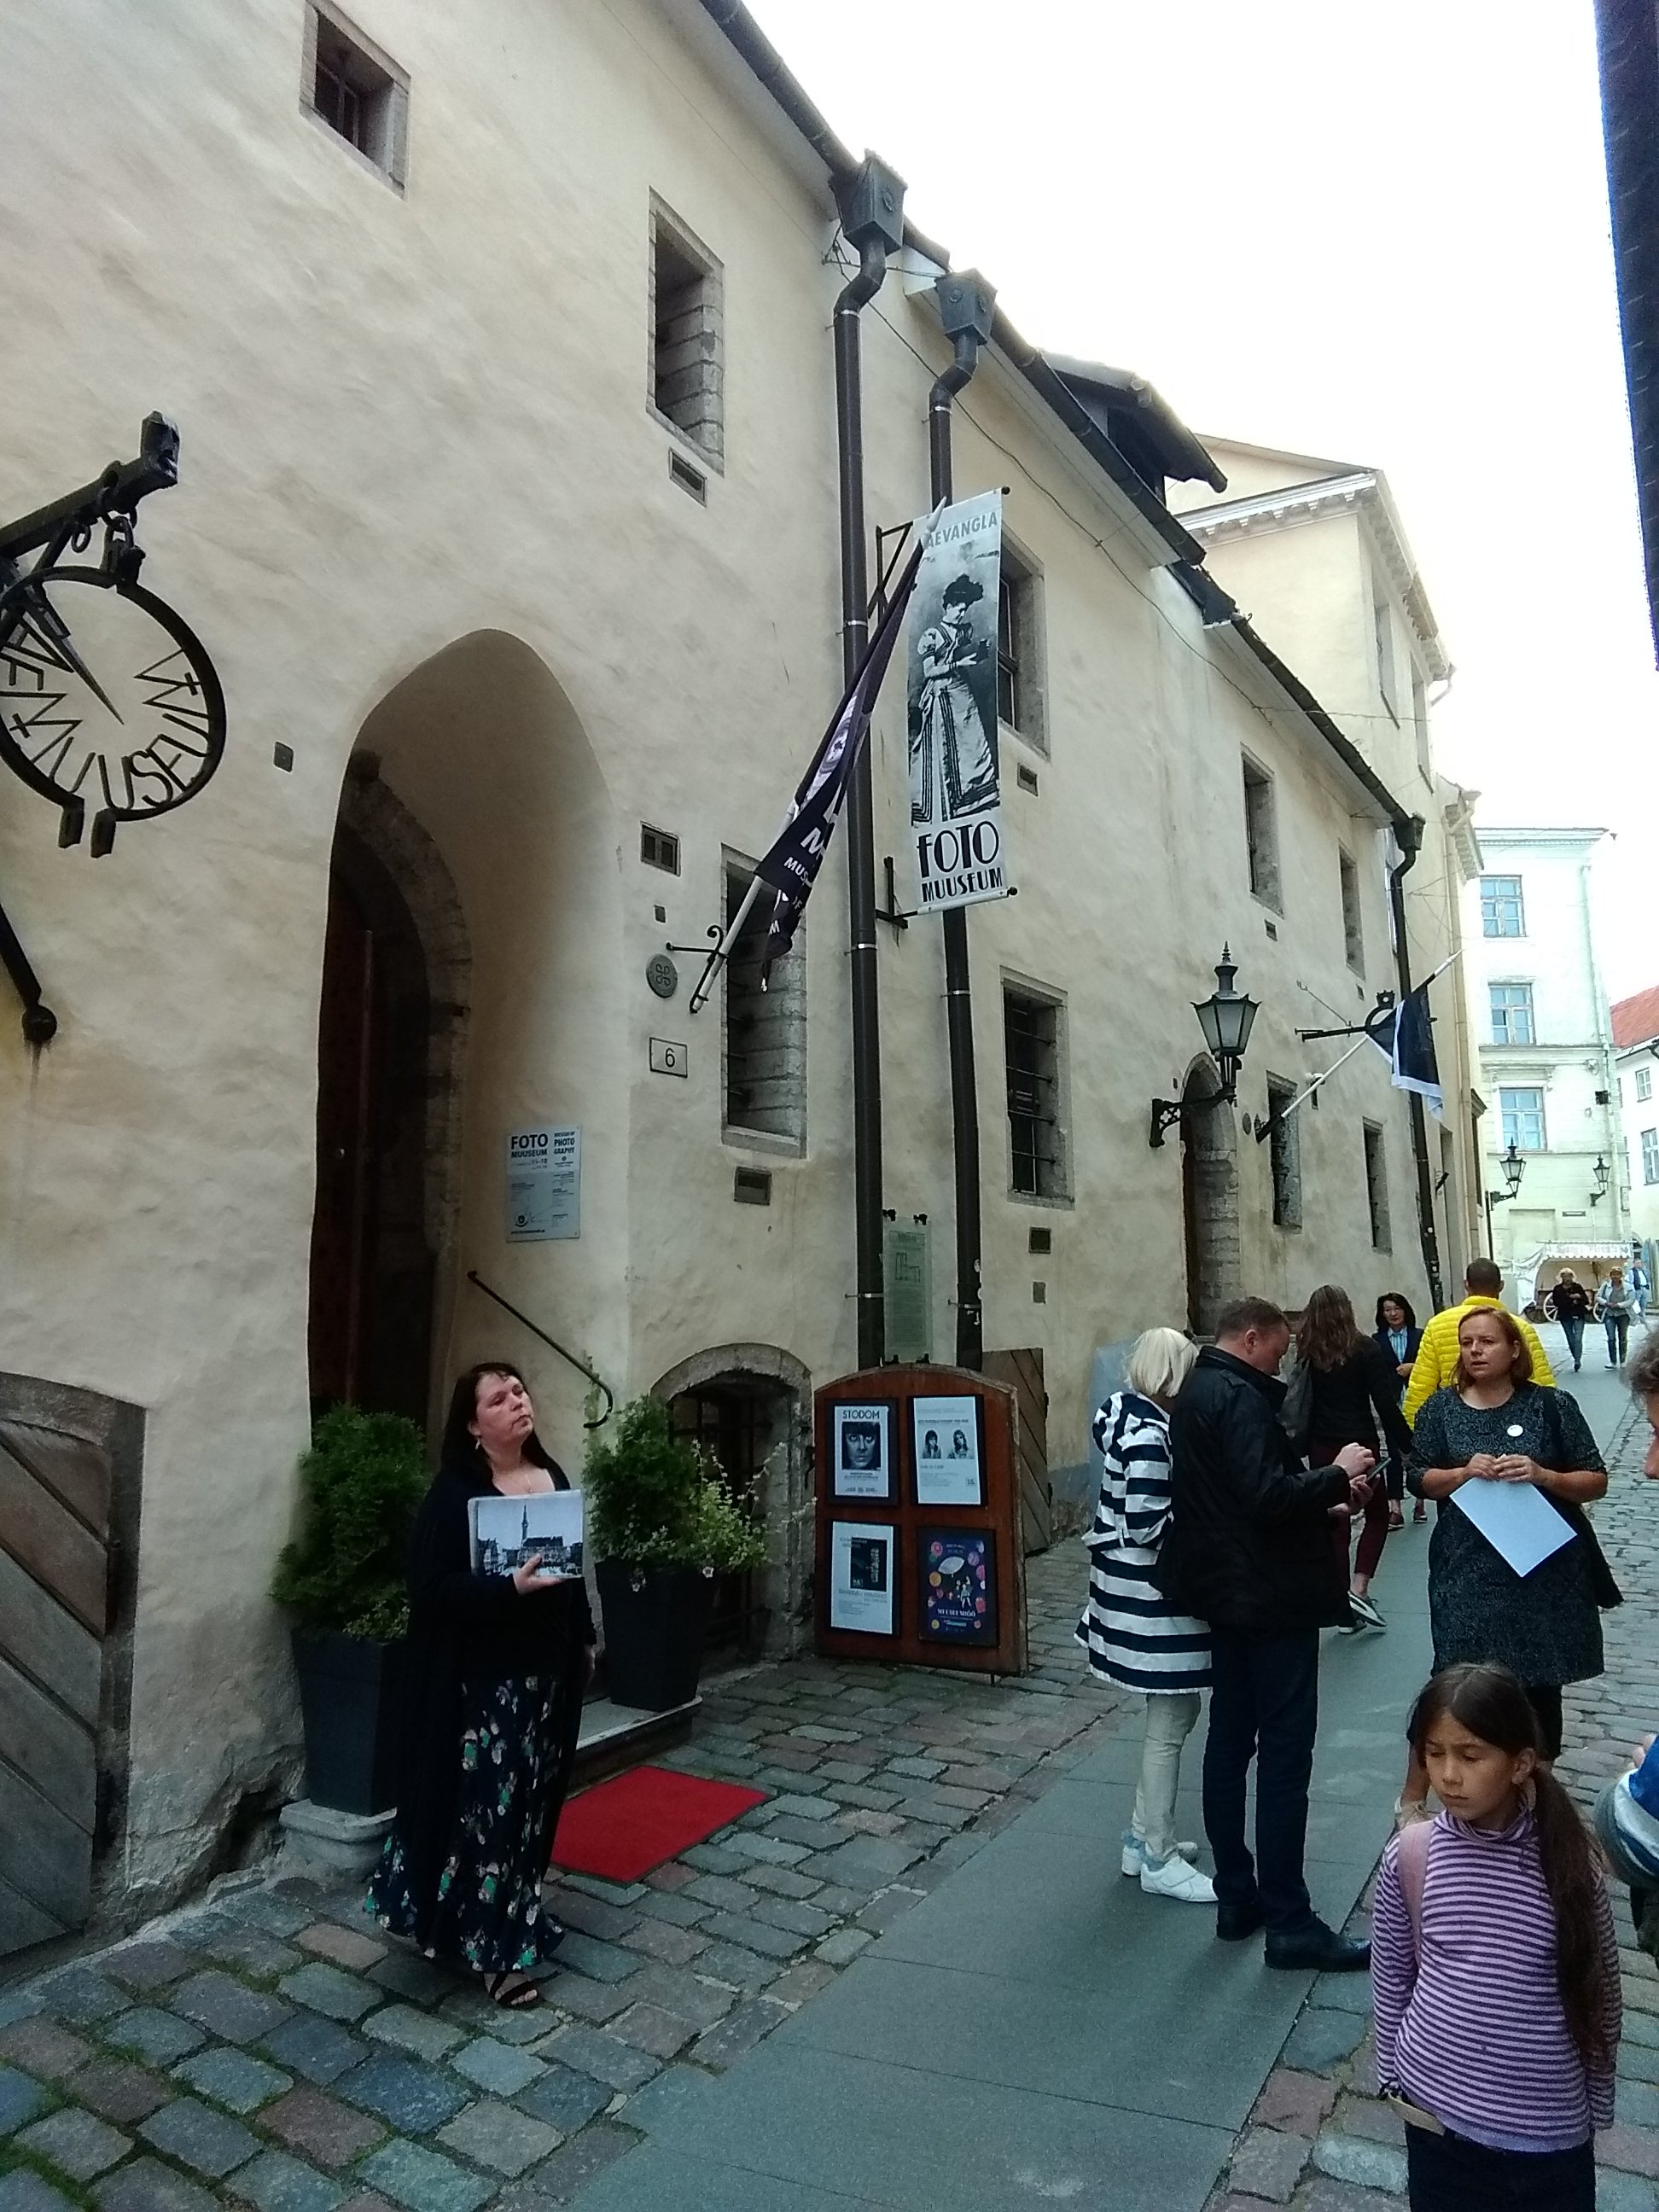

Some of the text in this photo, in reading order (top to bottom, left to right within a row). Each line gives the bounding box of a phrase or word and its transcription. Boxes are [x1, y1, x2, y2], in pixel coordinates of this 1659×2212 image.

[927, 512, 998, 548] AEVANGLA
[917, 821, 999, 878] FOTO
[922, 867, 1003, 902] MUUSEUM
[665, 1047, 676, 1068] 6
[510, 1133, 549, 1150] FOTO
[554, 1138, 575, 1147] PHOTO
[510, 1149, 548, 1158] MUUSEUM
